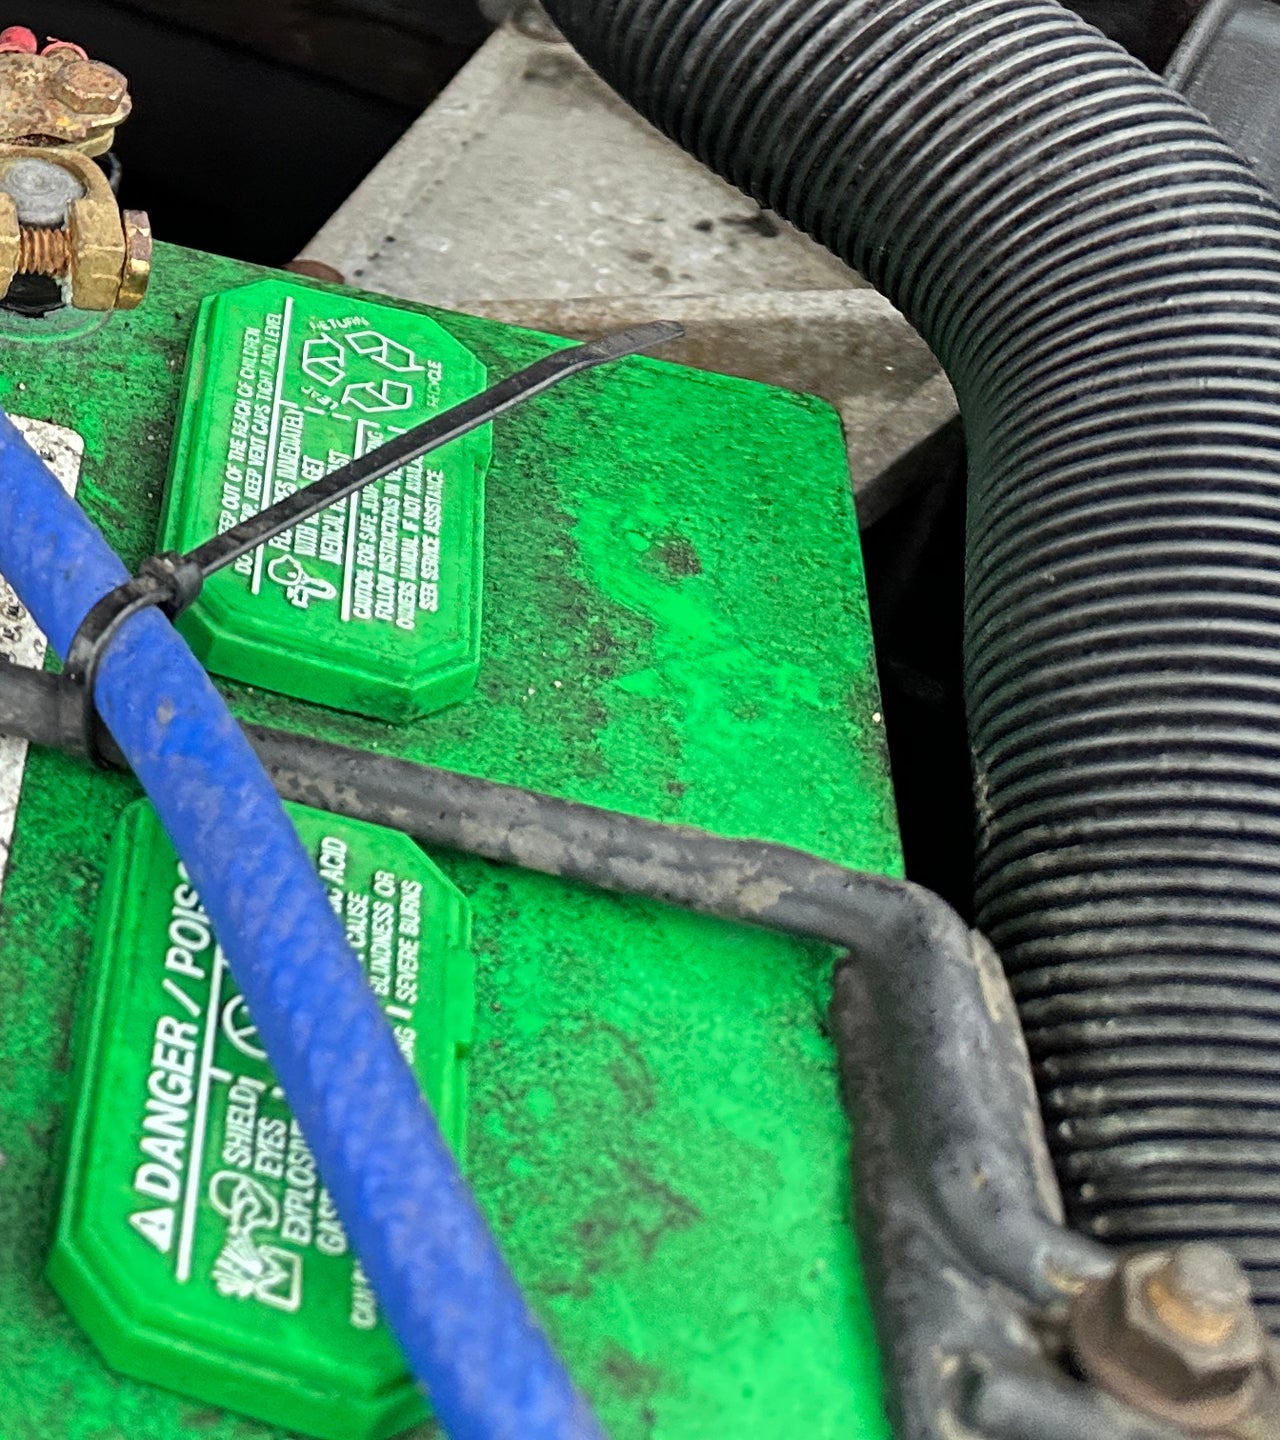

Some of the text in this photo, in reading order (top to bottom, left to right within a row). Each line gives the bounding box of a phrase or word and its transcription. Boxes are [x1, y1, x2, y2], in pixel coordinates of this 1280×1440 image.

[263, 311, 281, 343] LEVEL
[260, 343, 278, 367] AND
[256, 368, 274, 402] TIGHT
[218, 326, 260, 538] EEP OUT OF THE REACH OF CHILDREN
[251, 402, 270, 435] CAPS
[276, 406, 304, 480] IMMEDIATELY
[247, 434, 266, 467] VENT
[300, 454, 325, 482] GET
[243, 467, 262, 501] KEEP
[384, 481, 399, 496] IN
[403, 493, 419, 519] NOT
[293, 522, 318, 557] WITH
[319, 511, 344, 564] MEDICAL
[360, 512, 376, 542] SAFE
[380, 495, 397, 574] INSTRUCTIONS
[402, 518, 417, 533] IF
[420, 467, 441, 612] SEEK SERVICE ASSISTANCE
[357, 541, 374, 568] FOR
[376, 573, 393, 621] FOLLOW
[319, 834, 345, 885] ACID
[163, 859, 210, 980] POIS
[345, 890, 367, 949] CAUSE
[369, 869, 395, 996] BLINDNESS OR
[399, 878, 420, 938] BURNS
[395, 936, 419, 1004] SEVERE
[132, 1013, 199, 1203] DANGER
[223, 1084, 256, 1169] SHIELD
[253, 1116, 286, 1179] EYES
